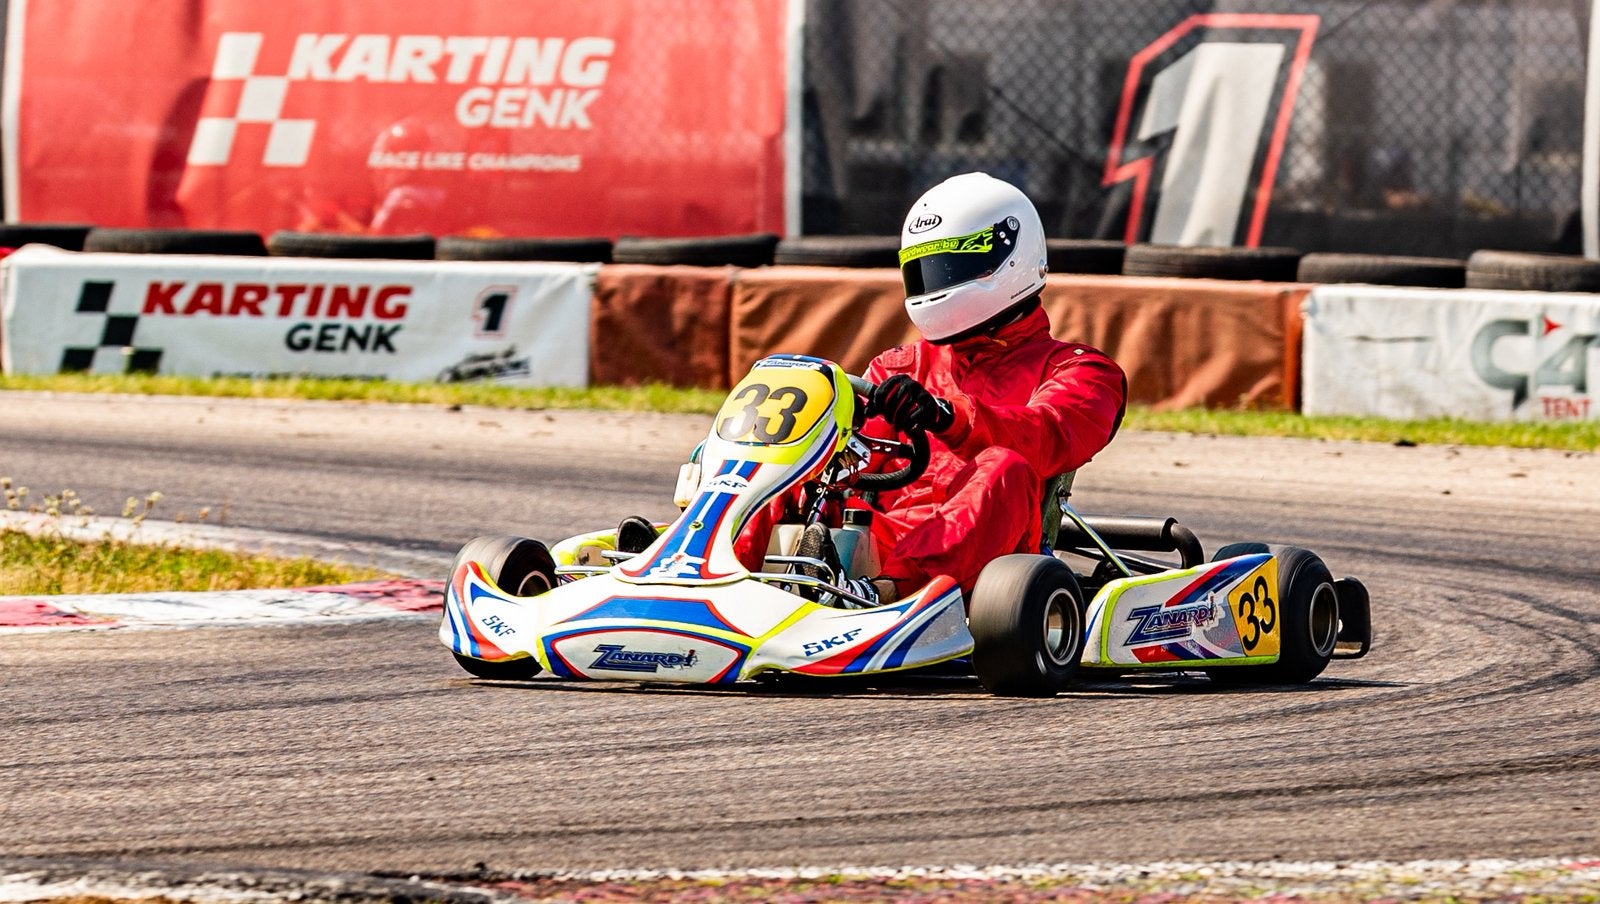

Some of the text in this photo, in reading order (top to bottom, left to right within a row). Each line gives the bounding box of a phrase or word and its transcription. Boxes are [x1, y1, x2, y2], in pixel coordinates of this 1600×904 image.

[290, 34, 614, 86] KARTING
[456, 87, 599, 129] GENK
[368, 151, 582, 172] RACE LIKE CHAMPIONS
[1138, 42, 1285, 248] 1
[914, 213, 937, 230] Arai
[142, 282, 414, 321] KARTING
[285, 323, 401, 354] GENK
[720, 383, 808, 444] 33
[481, 614, 516, 638] SKF
[1239, 575, 1276, 651] 33
[802, 628, 863, 657] SKF
